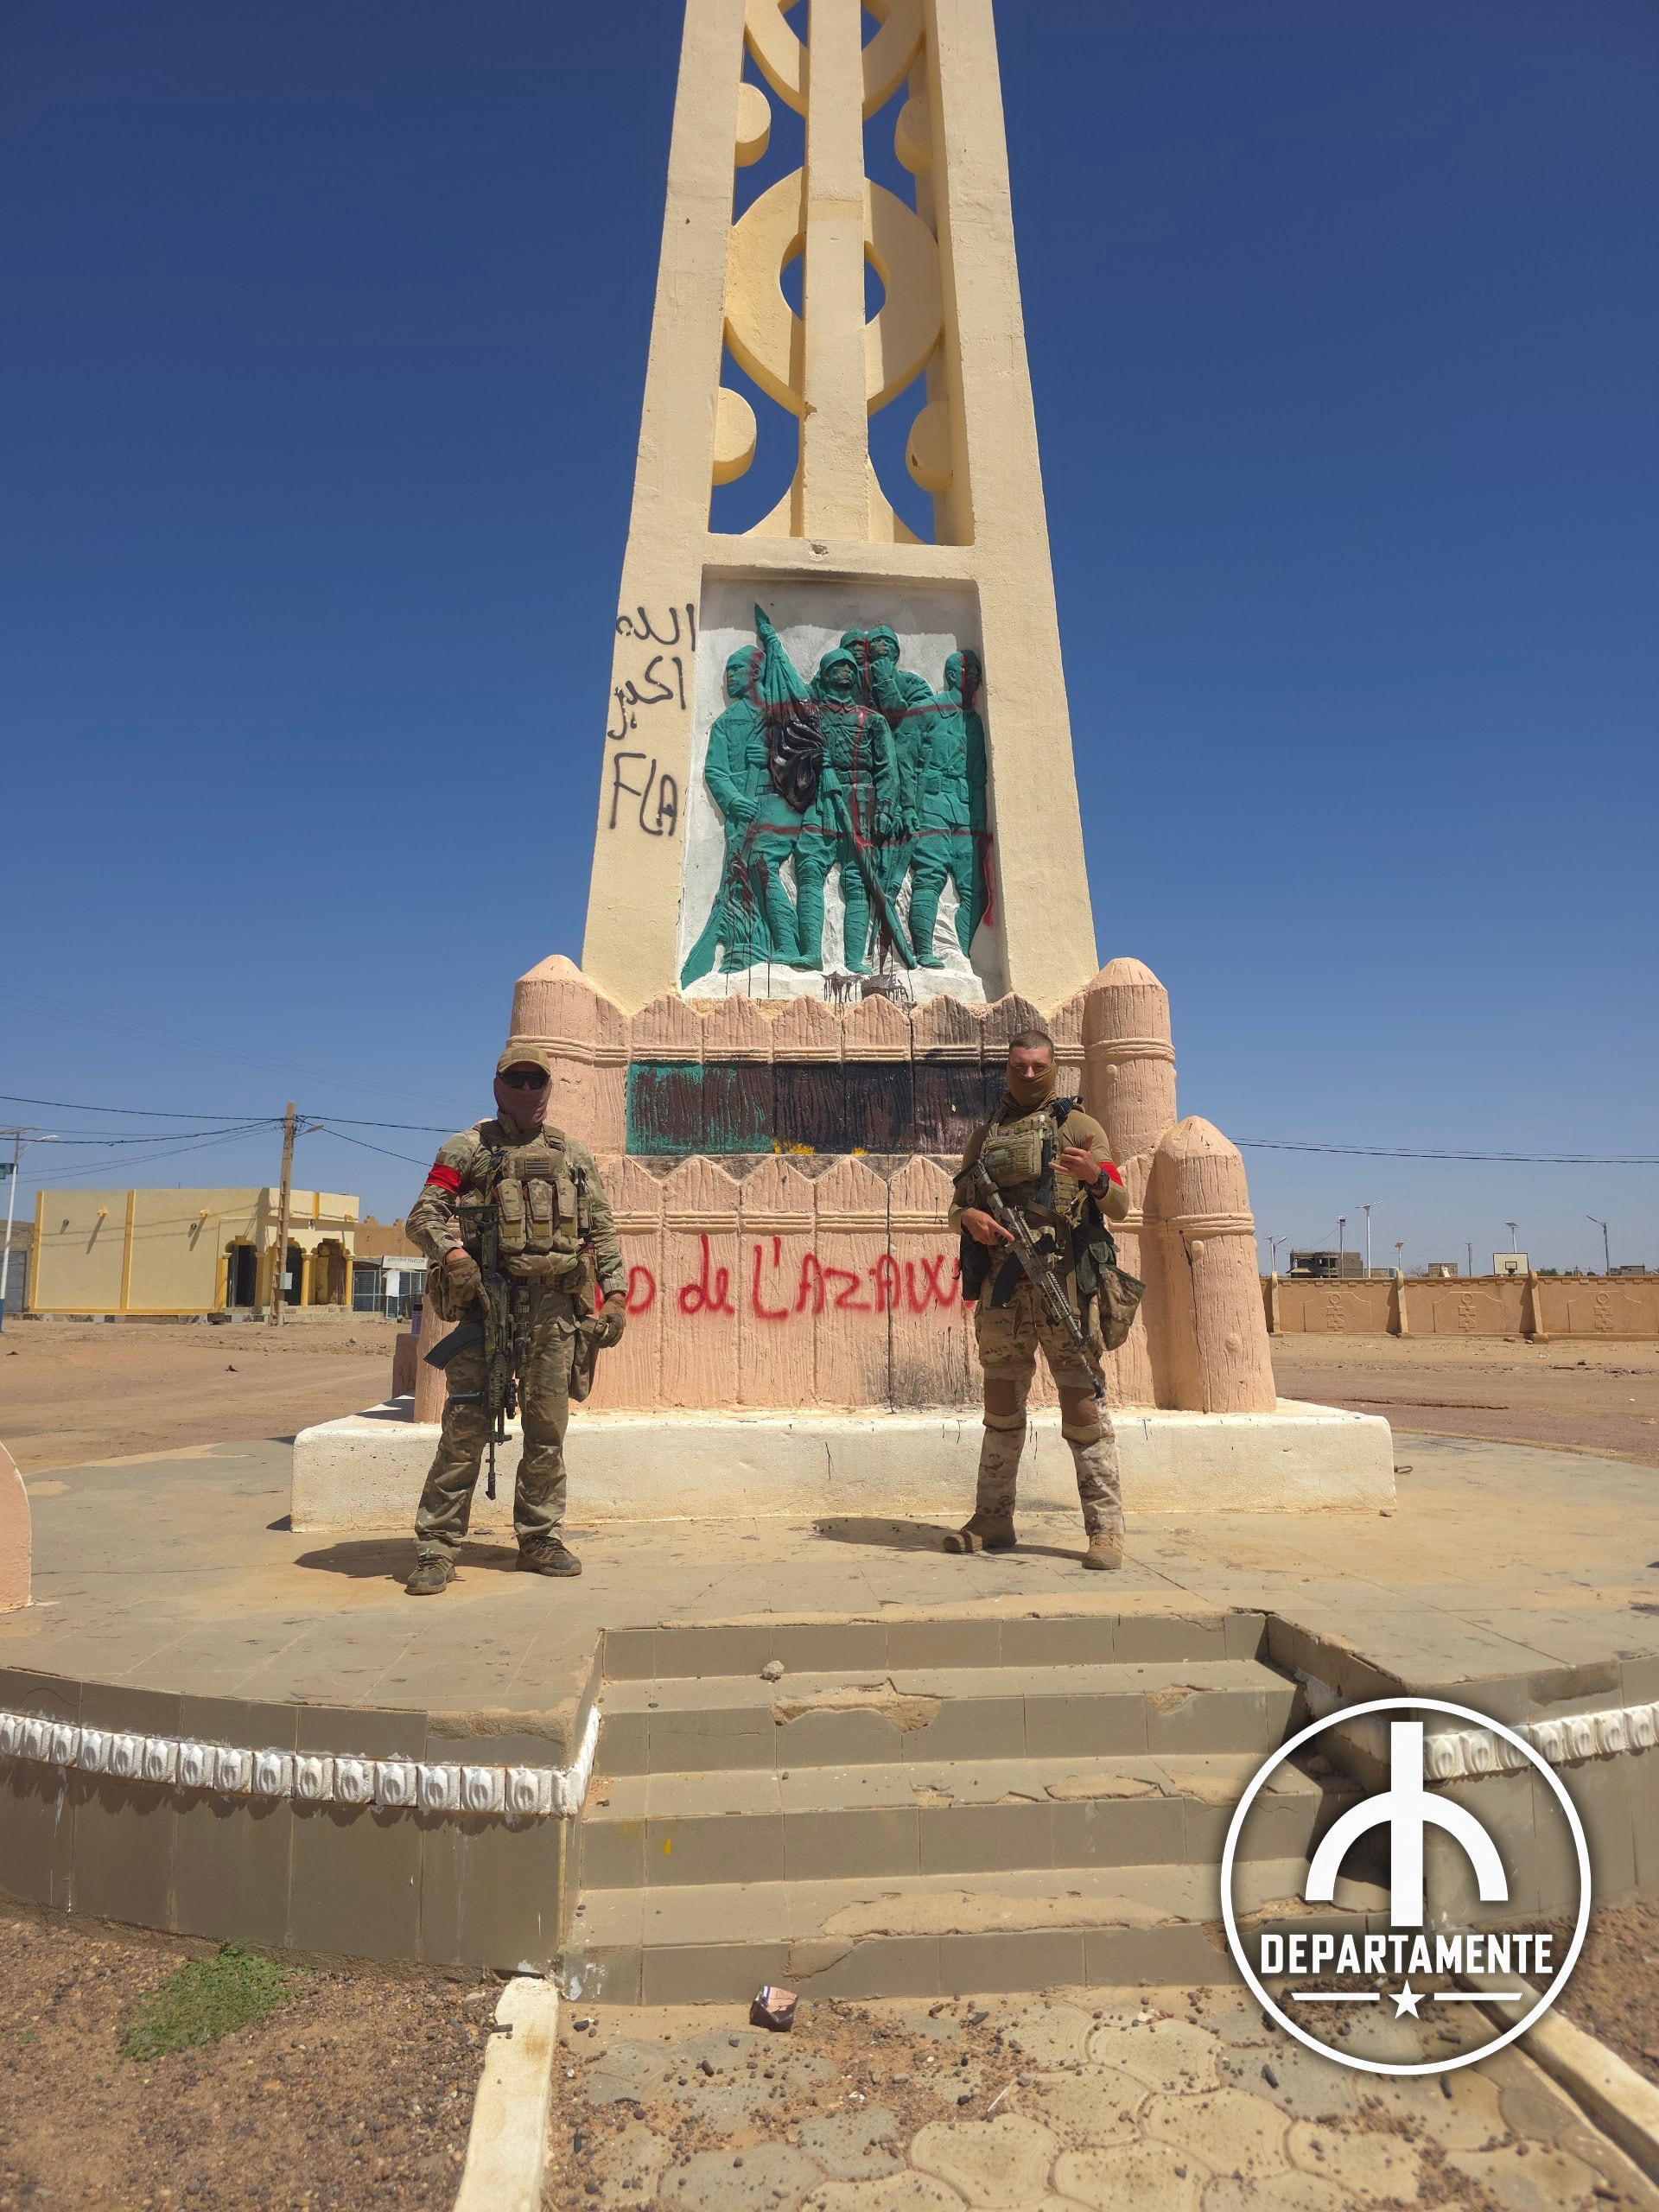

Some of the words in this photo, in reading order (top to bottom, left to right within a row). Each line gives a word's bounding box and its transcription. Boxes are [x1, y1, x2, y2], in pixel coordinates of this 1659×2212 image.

[616, 603, 696, 652] الله
[608, 752, 678, 836] FLA
[677, 1233, 734, 1316] de
